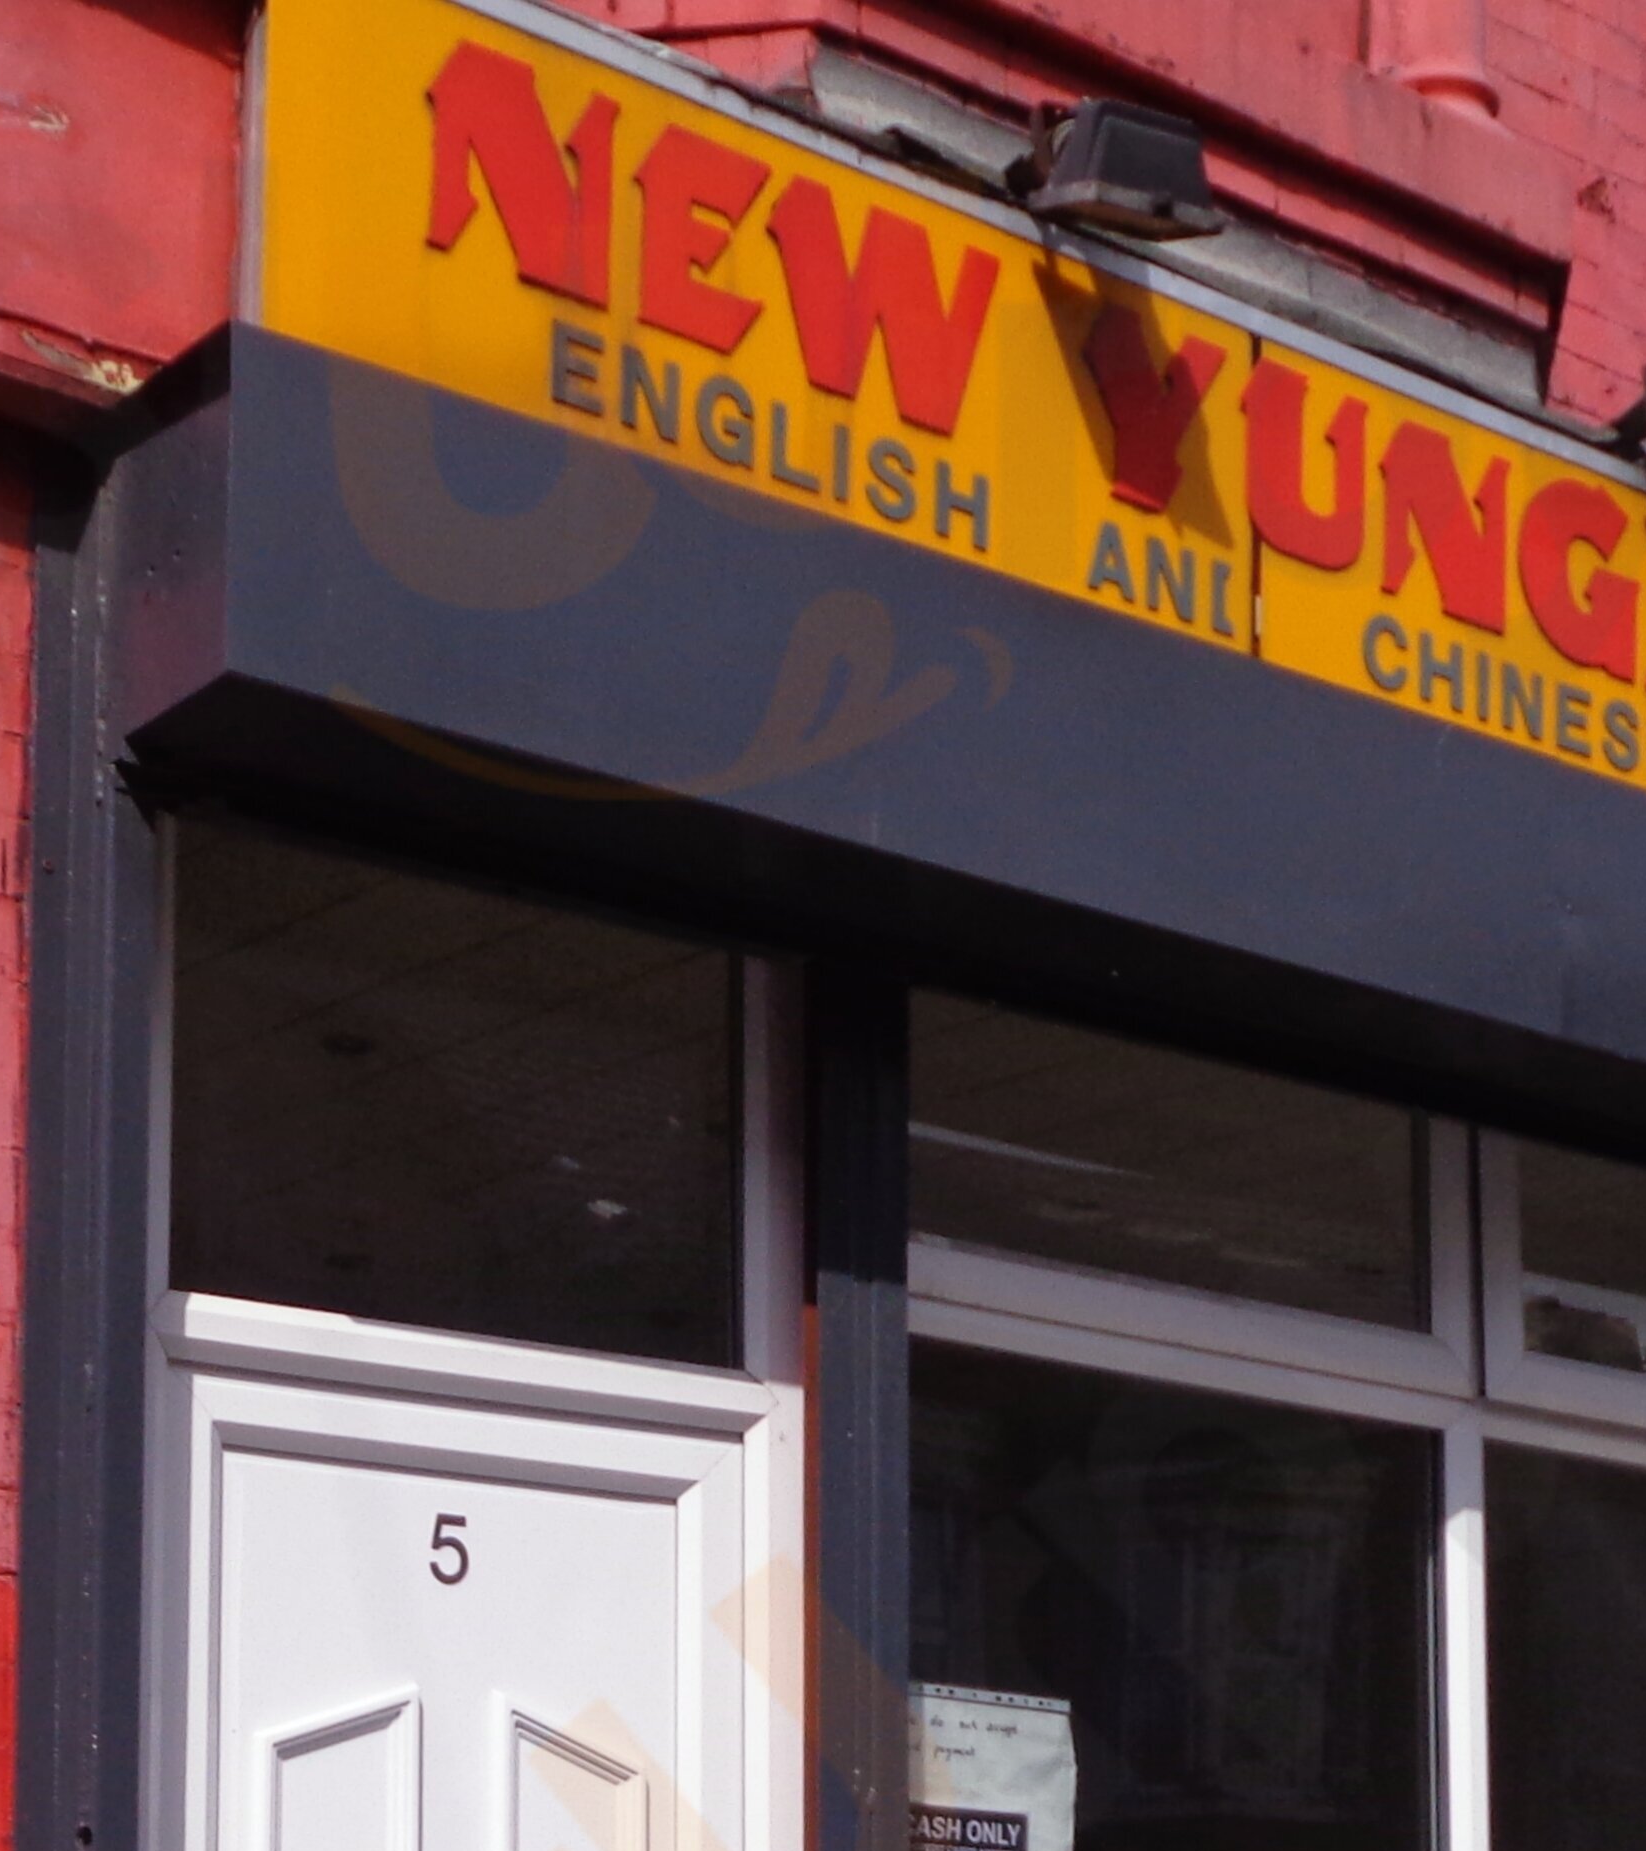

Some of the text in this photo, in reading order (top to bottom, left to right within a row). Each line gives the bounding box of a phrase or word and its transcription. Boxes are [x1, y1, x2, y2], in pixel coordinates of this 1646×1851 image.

[425, 38, 1000, 438] NEW
[550, 317, 990, 551] ENGLISH
[429, 1512, 469, 1585] 5
[966, 1819, 1021, 1846] ONLY
